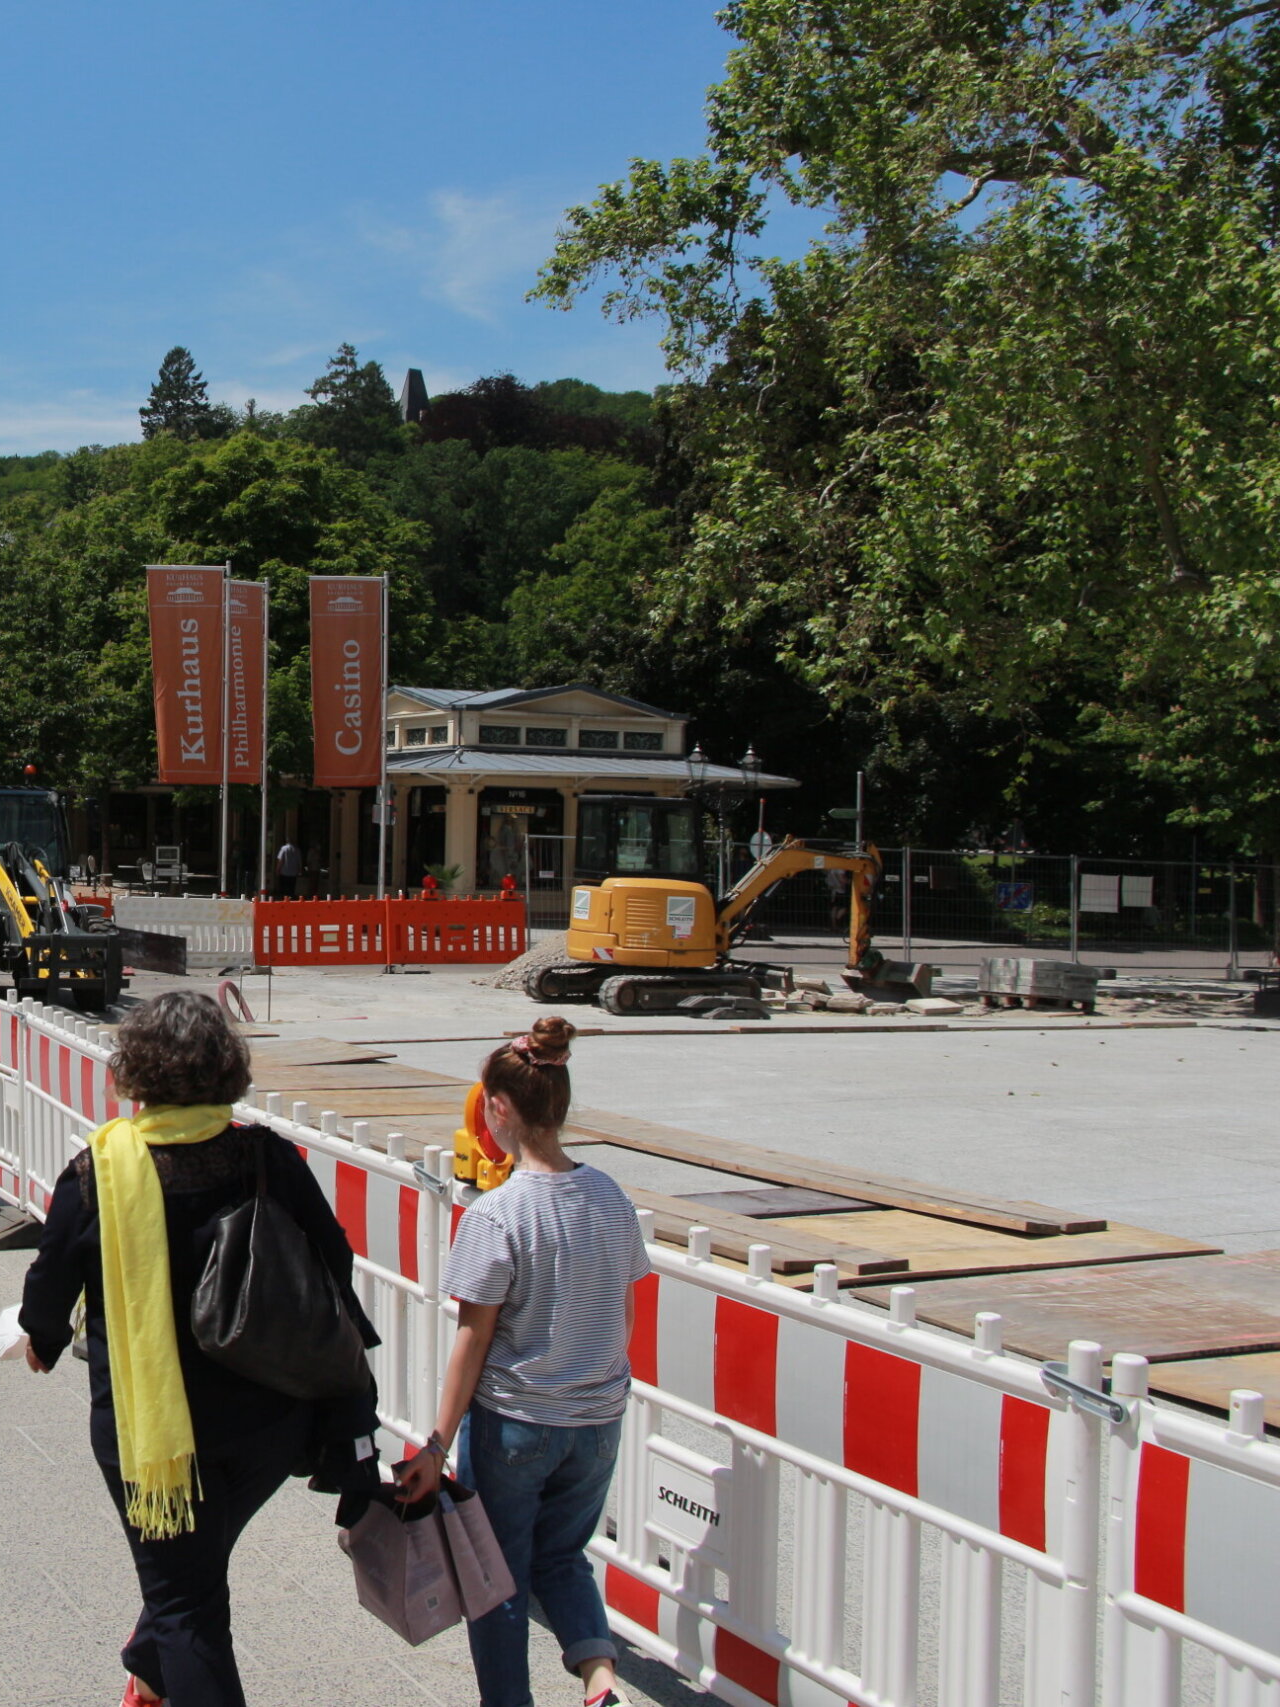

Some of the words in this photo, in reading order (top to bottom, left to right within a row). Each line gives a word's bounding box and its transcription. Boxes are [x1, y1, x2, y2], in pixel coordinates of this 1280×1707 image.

[176, 618, 206, 764] Kurhaus
[231, 625, 249, 768] Philharmonie
[334, 639, 362, 755] Casino
[658, 1486, 720, 1526] SCHLEITH
